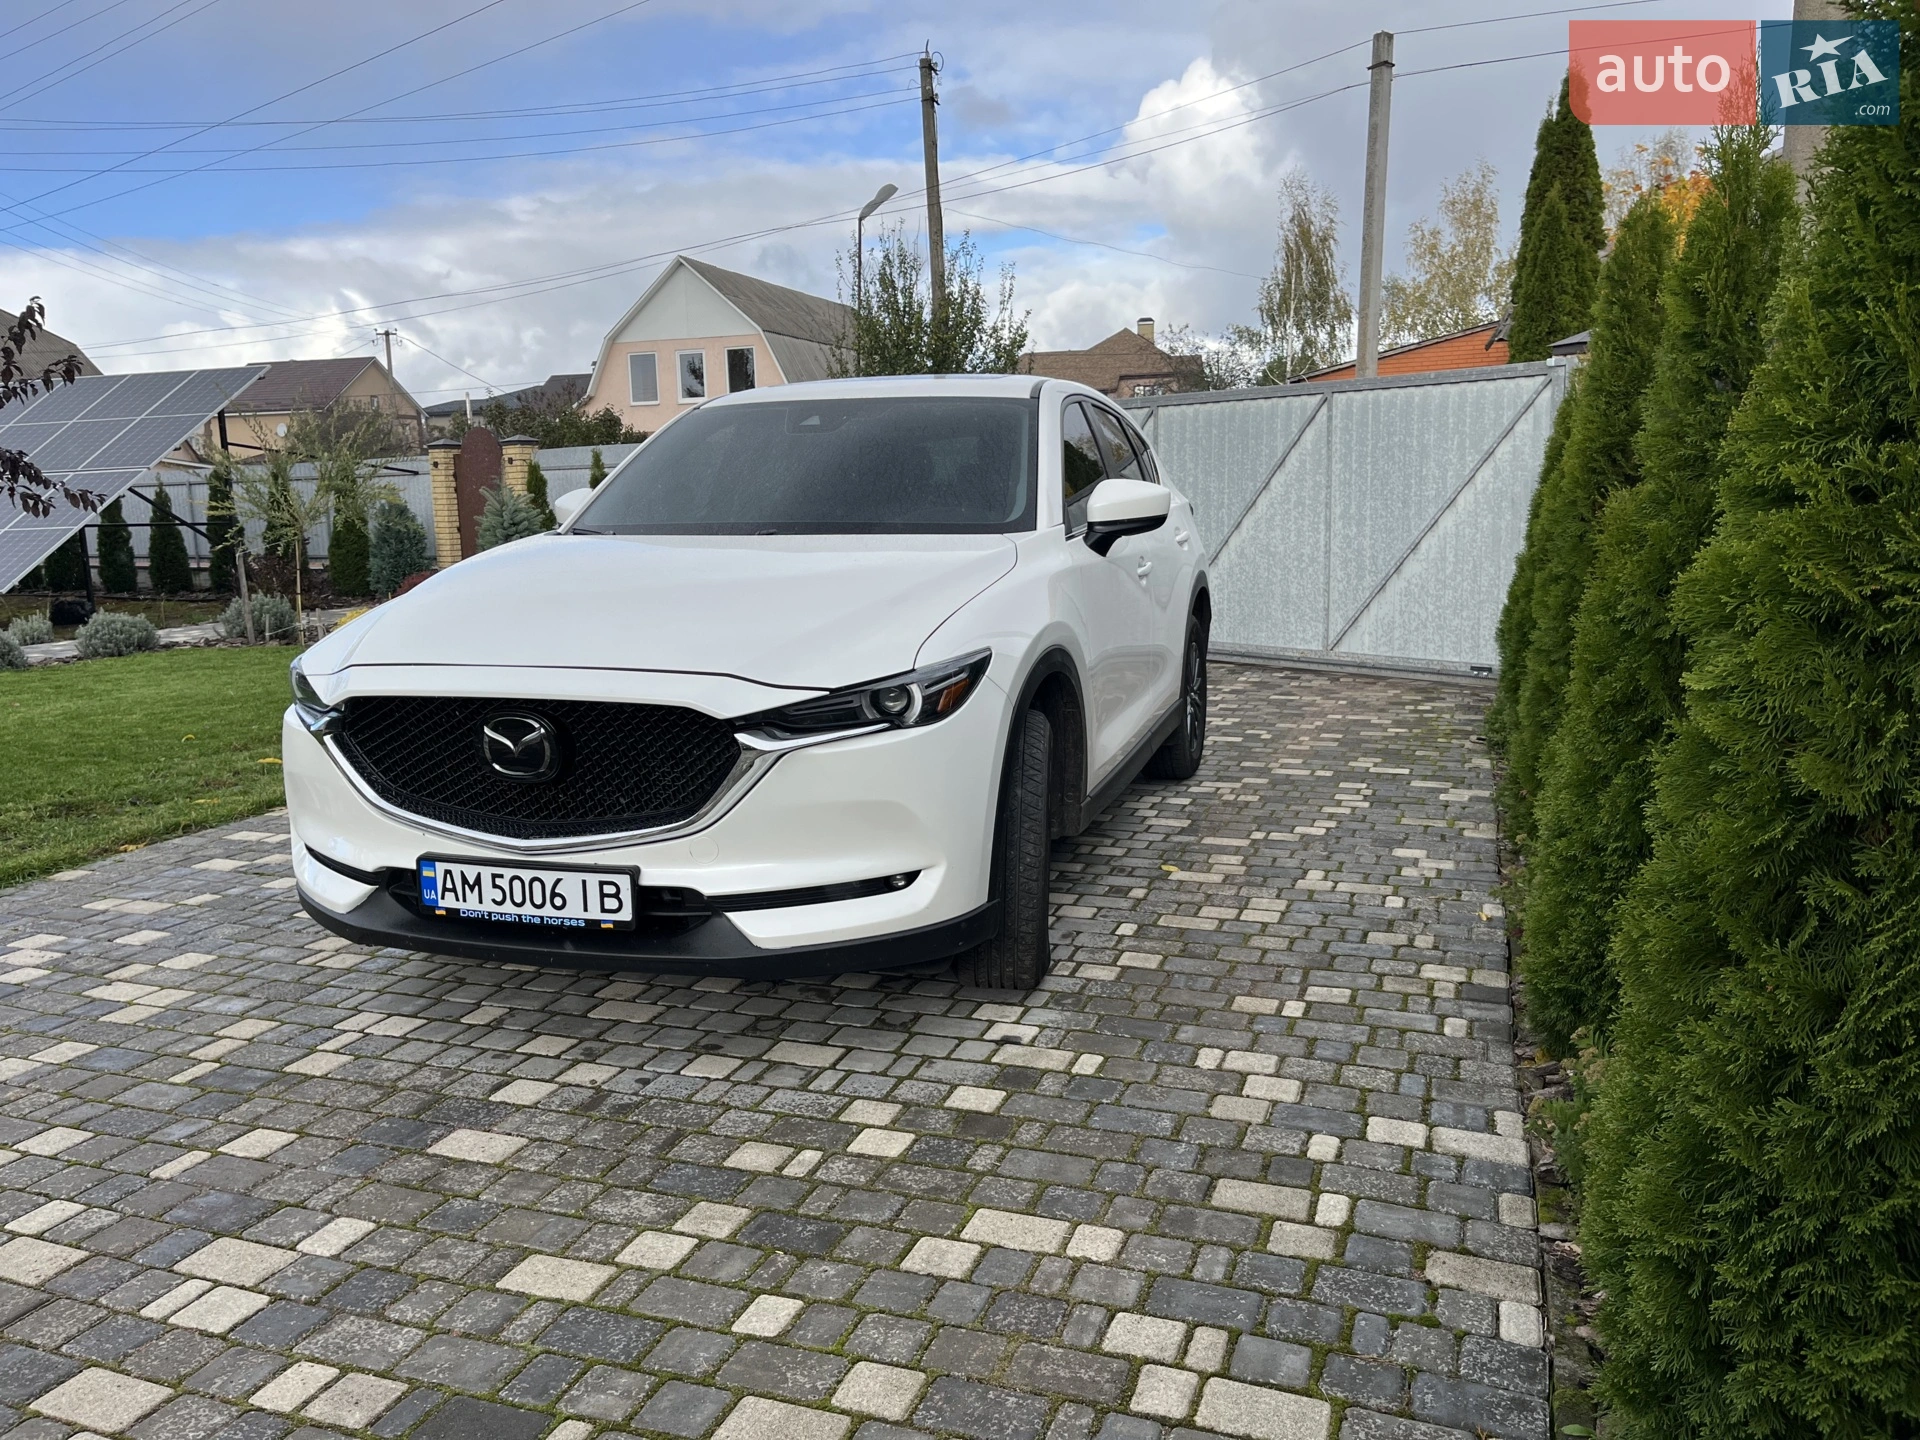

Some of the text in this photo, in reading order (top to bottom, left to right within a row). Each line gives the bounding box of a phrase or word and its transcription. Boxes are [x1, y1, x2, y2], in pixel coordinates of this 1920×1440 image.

[423, 888, 437, 900] UA
[440, 868, 624, 914] AM 5006 IB
[459, 908, 586, 927] Don't push the horses
